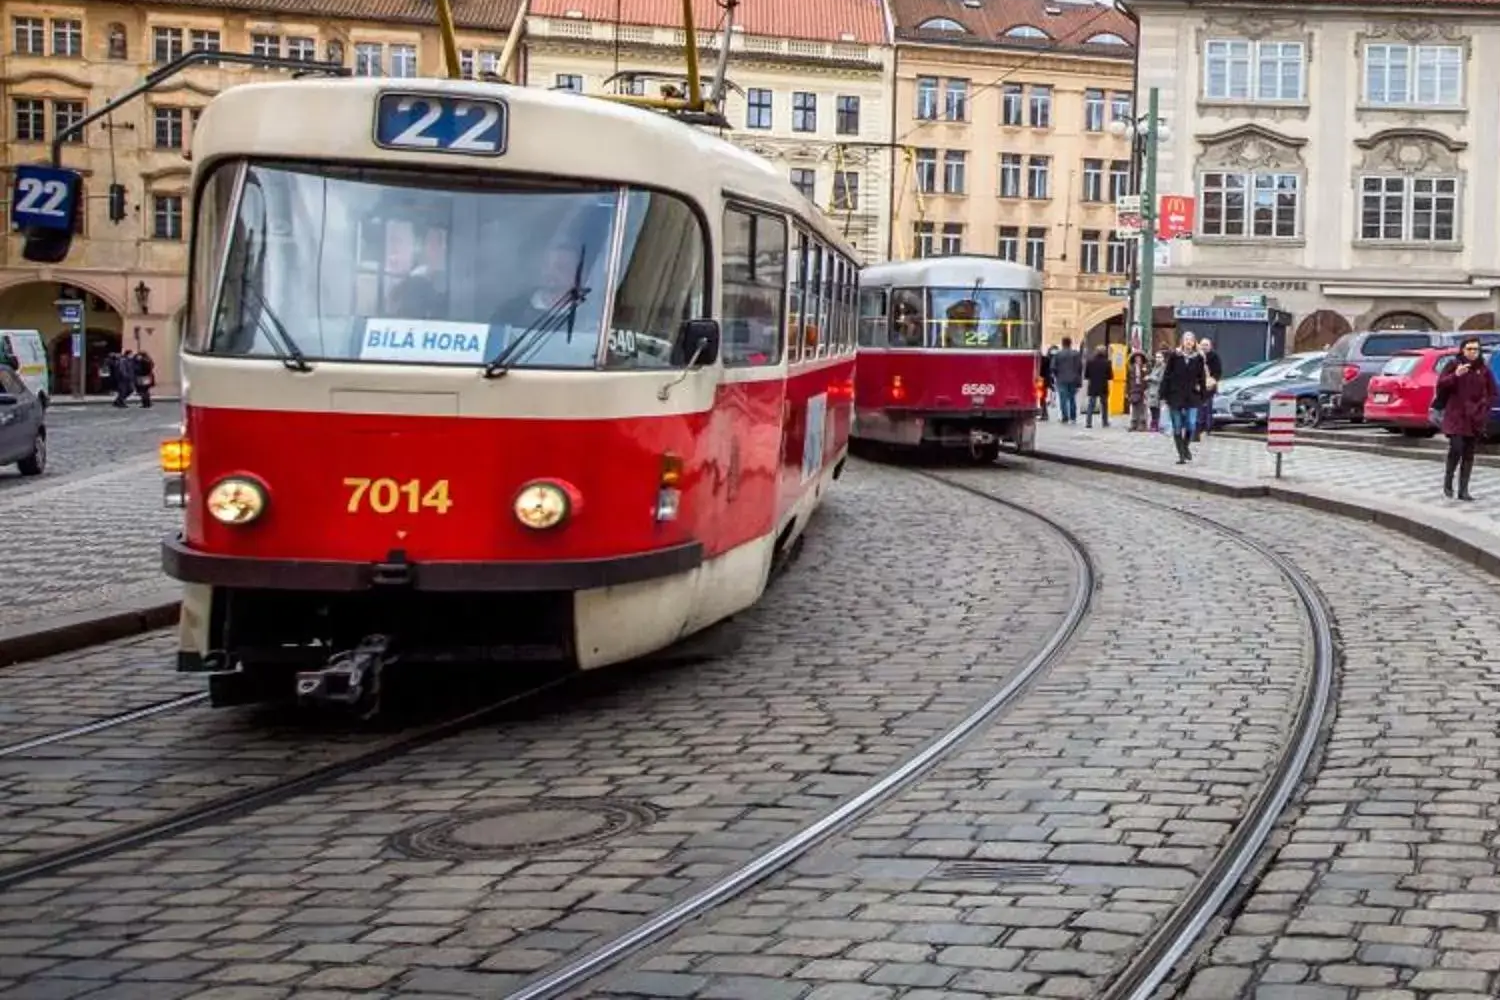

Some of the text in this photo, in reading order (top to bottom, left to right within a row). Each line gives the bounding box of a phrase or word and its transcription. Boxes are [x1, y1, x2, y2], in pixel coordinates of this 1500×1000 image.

[392, 100, 498, 151] 22
[16, 177, 68, 217] 22
[1185, 279, 1309, 292] STARBUCKS COFFEE
[367, 327, 480, 352] BÍLÁ HORA
[965, 332, 989, 346] 22
[343, 477, 453, 514] 7014
